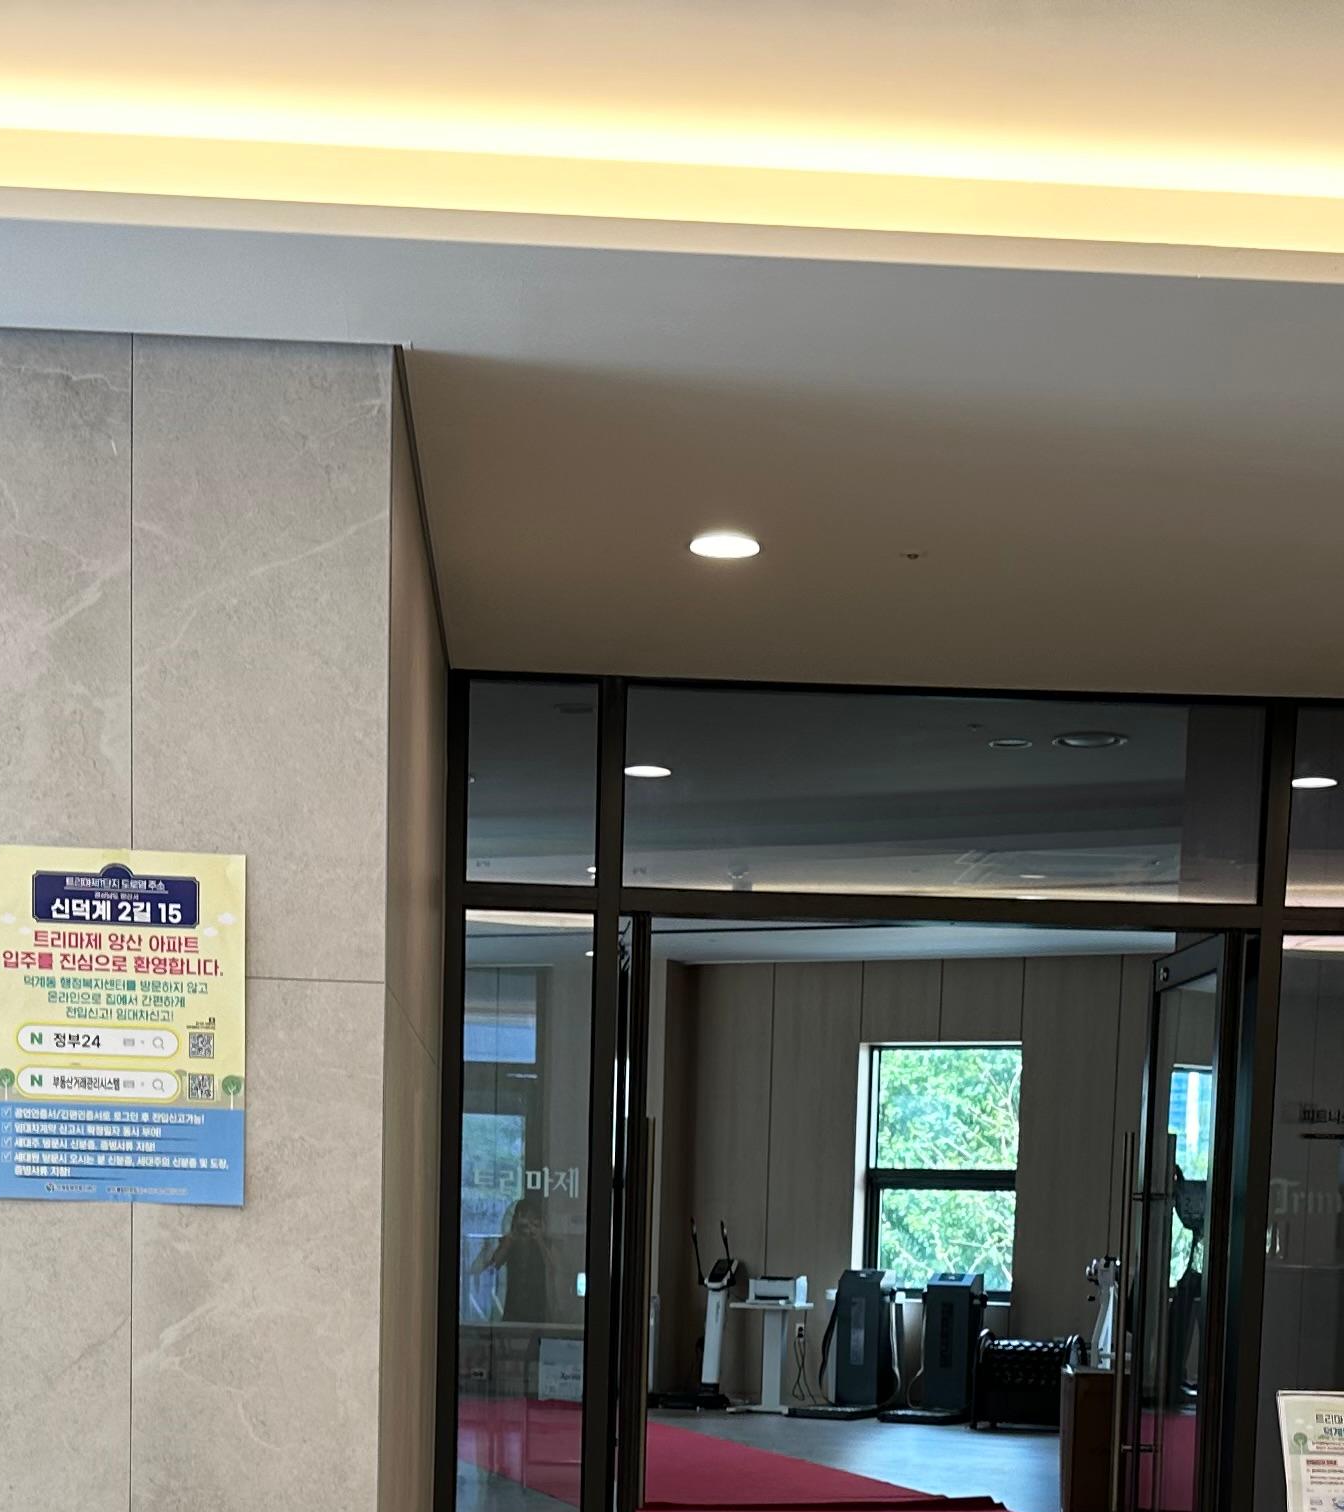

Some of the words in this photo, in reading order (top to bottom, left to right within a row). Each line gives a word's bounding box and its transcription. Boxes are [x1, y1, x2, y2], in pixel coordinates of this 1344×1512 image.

[51, 898, 111, 920] 신덕계
[118, 901, 151, 922] 2길
[158, 903, 182, 924] 15
[33, 930, 102, 949] 트리마제
[108, 934, 142, 952] 양산
[149, 935, 199, 954] 아파트
[60, 953, 128, 973] 진심으로
[30, 1033, 43, 1045] N
[53, 1033, 102, 1049] 정부24
[30, 1074, 43, 1087] N
[473, 1166, 579, 1198] 트리마제
